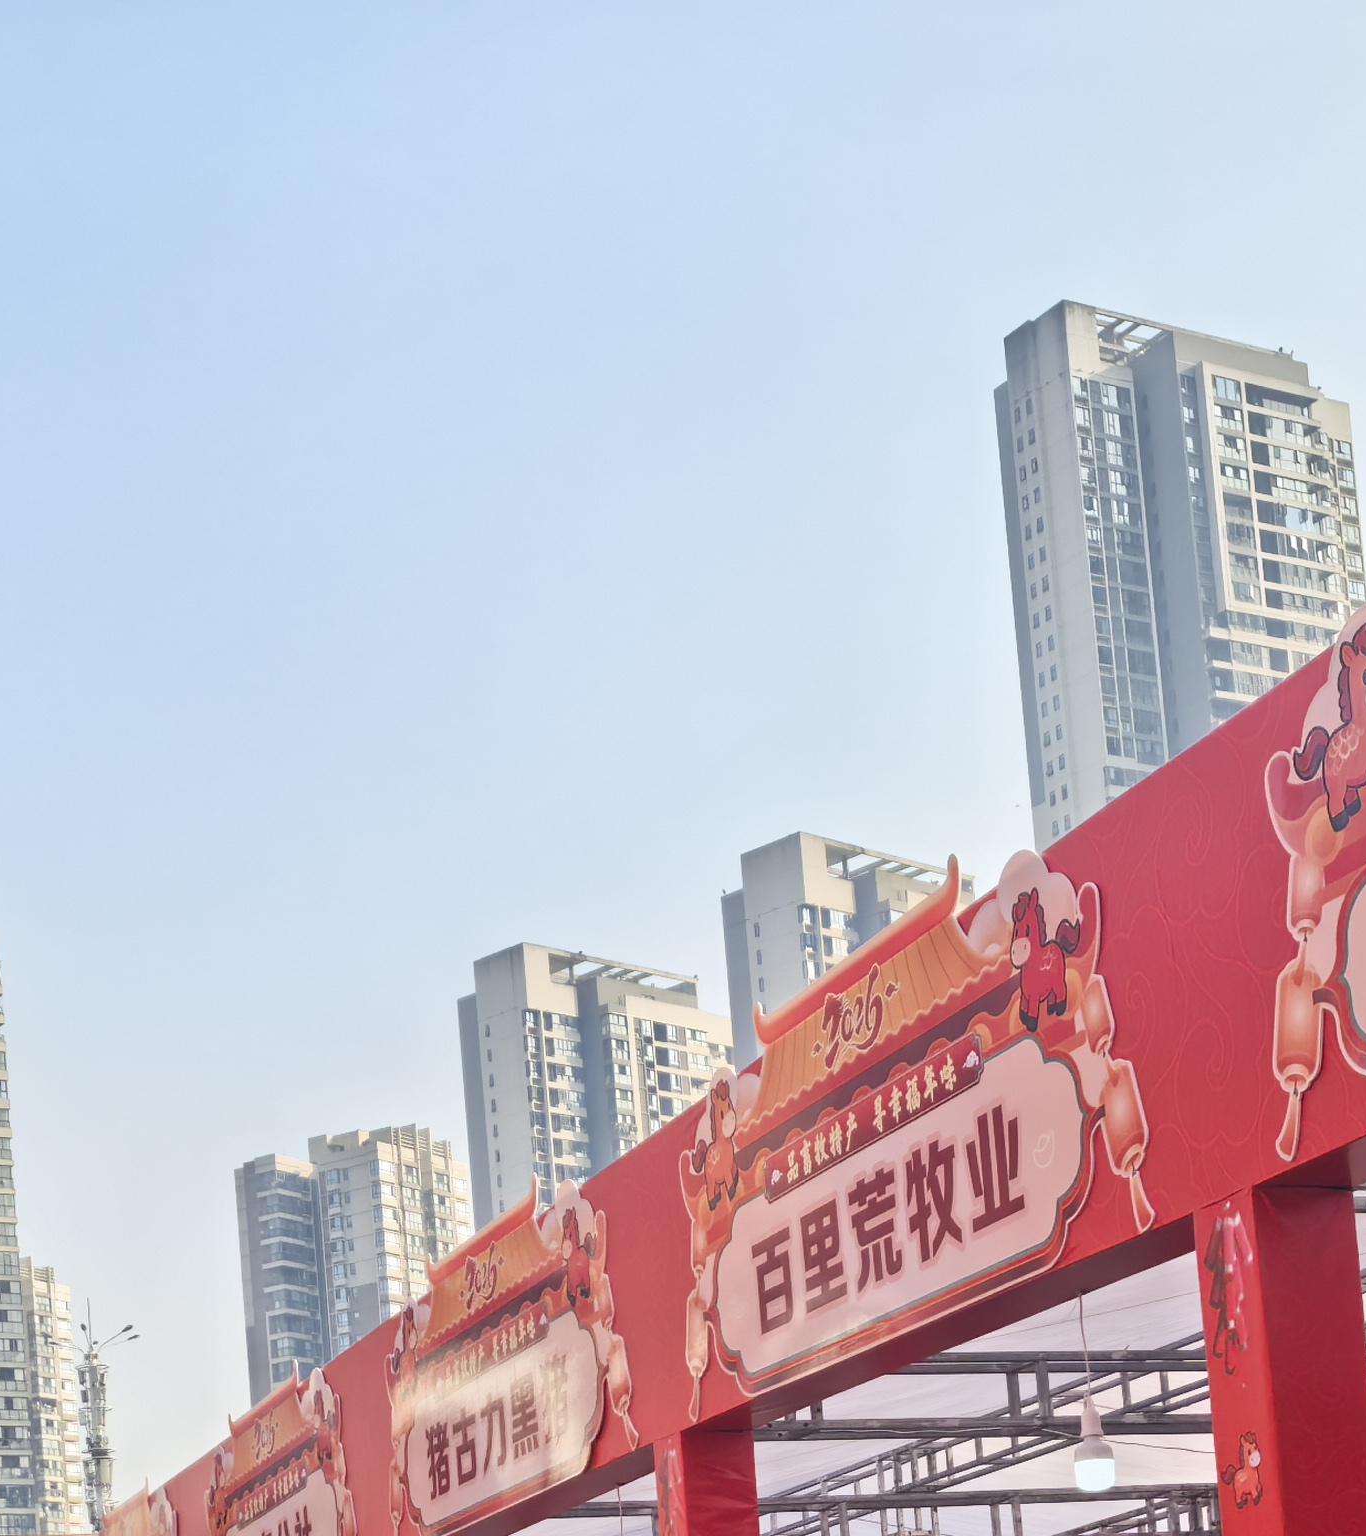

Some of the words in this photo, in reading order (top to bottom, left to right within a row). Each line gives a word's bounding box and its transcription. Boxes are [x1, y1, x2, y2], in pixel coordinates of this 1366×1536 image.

[821, 965, 882, 1069] 2026
[786, 1117, 859, 1184] 品畜牧特产
[752, 1104, 1026, 1335] 百里荒牧业
